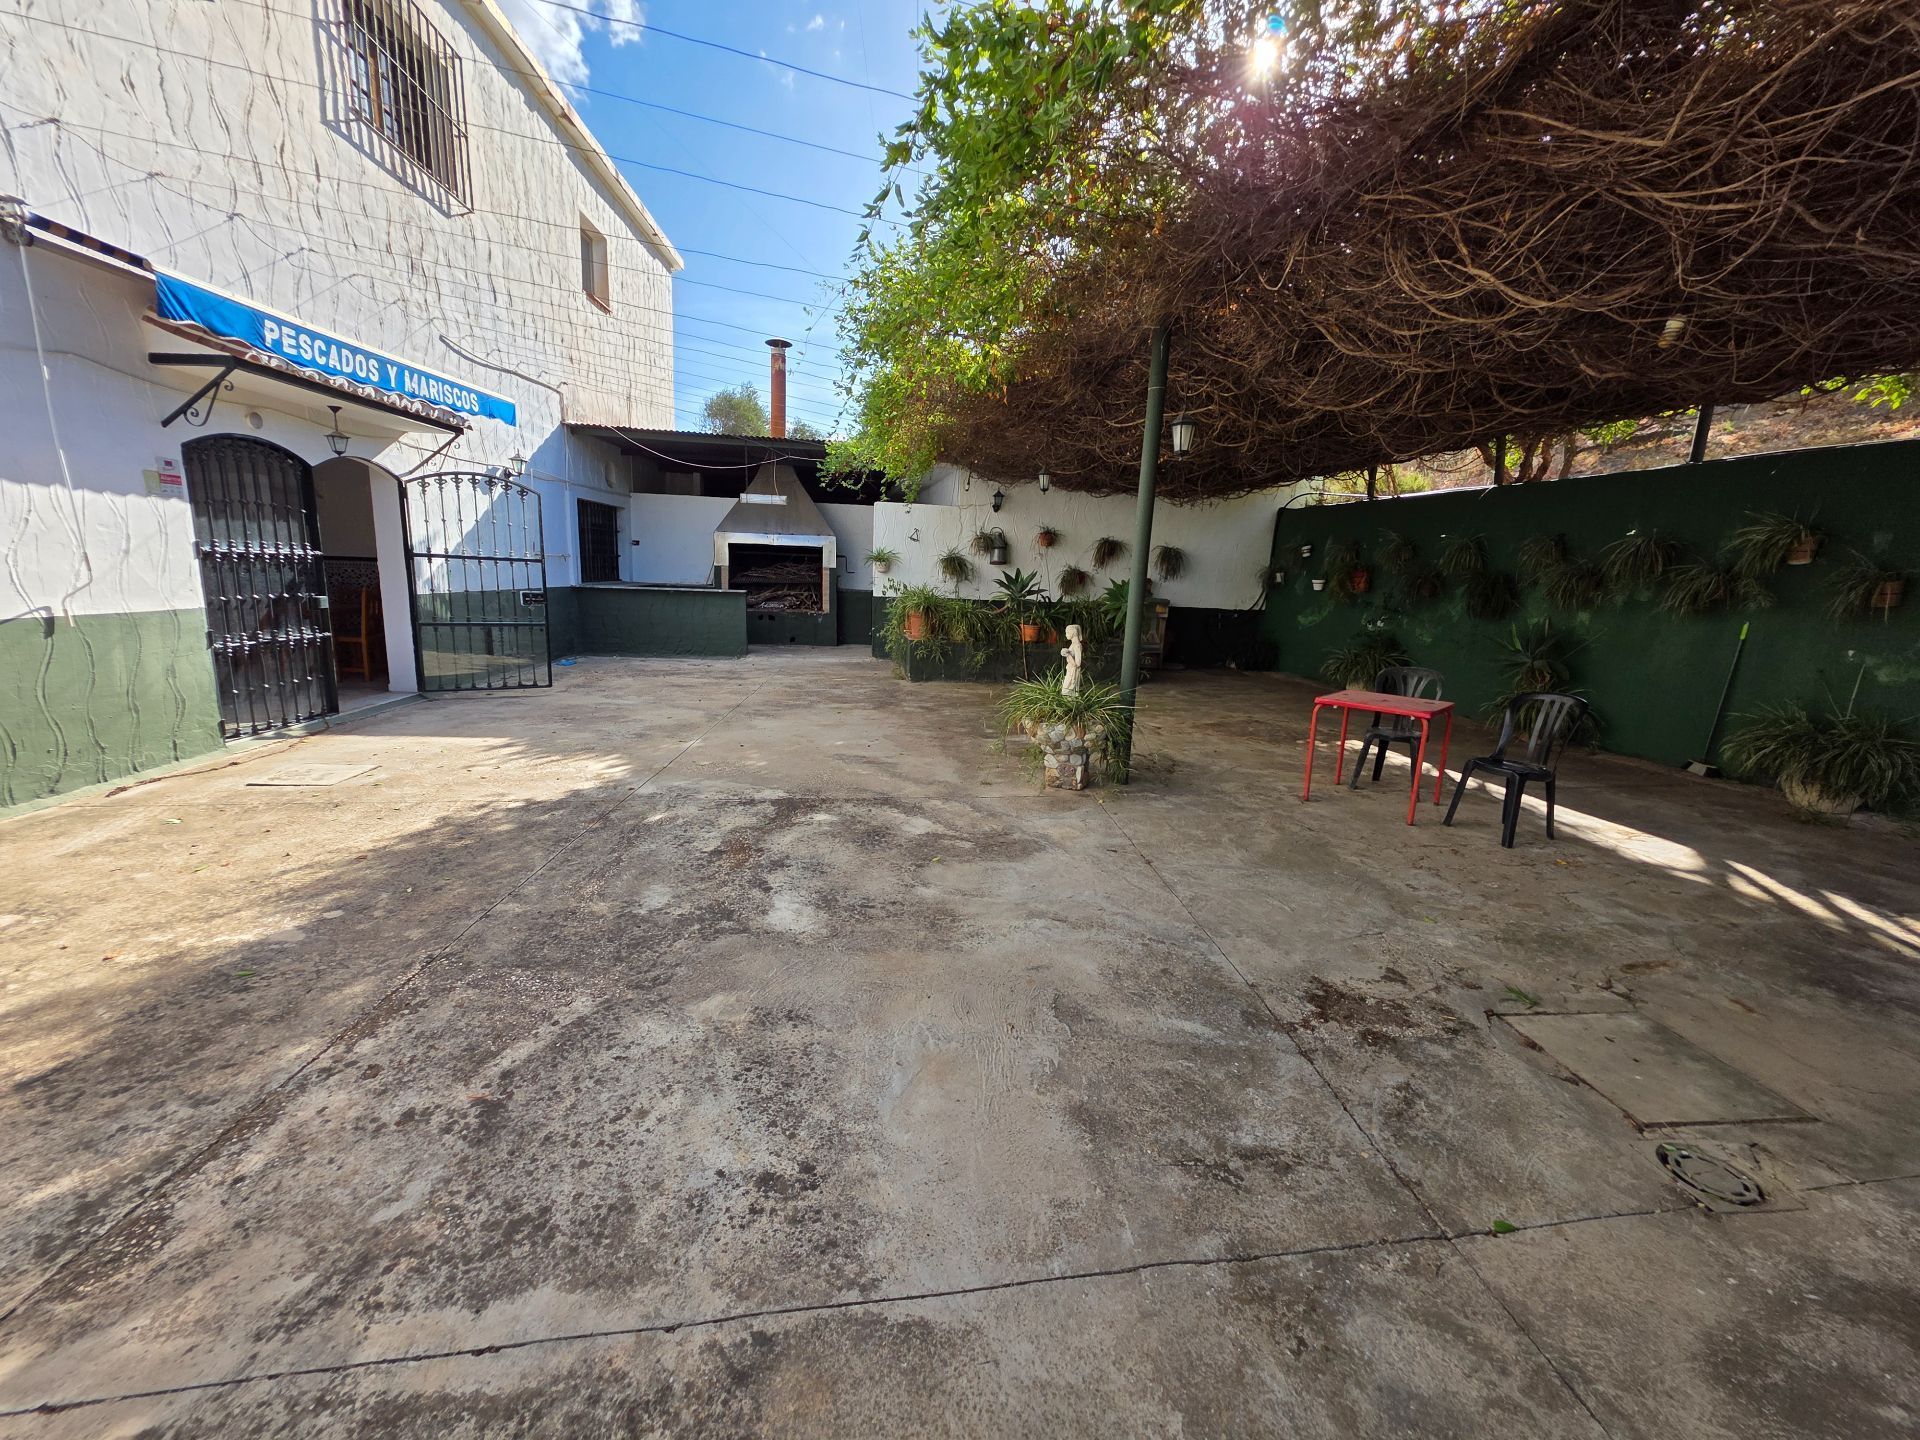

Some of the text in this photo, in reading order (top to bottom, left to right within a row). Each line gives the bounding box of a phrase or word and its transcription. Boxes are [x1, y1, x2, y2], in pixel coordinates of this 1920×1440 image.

[264, 319, 479, 412] PESCADOS Y MARISCOS
